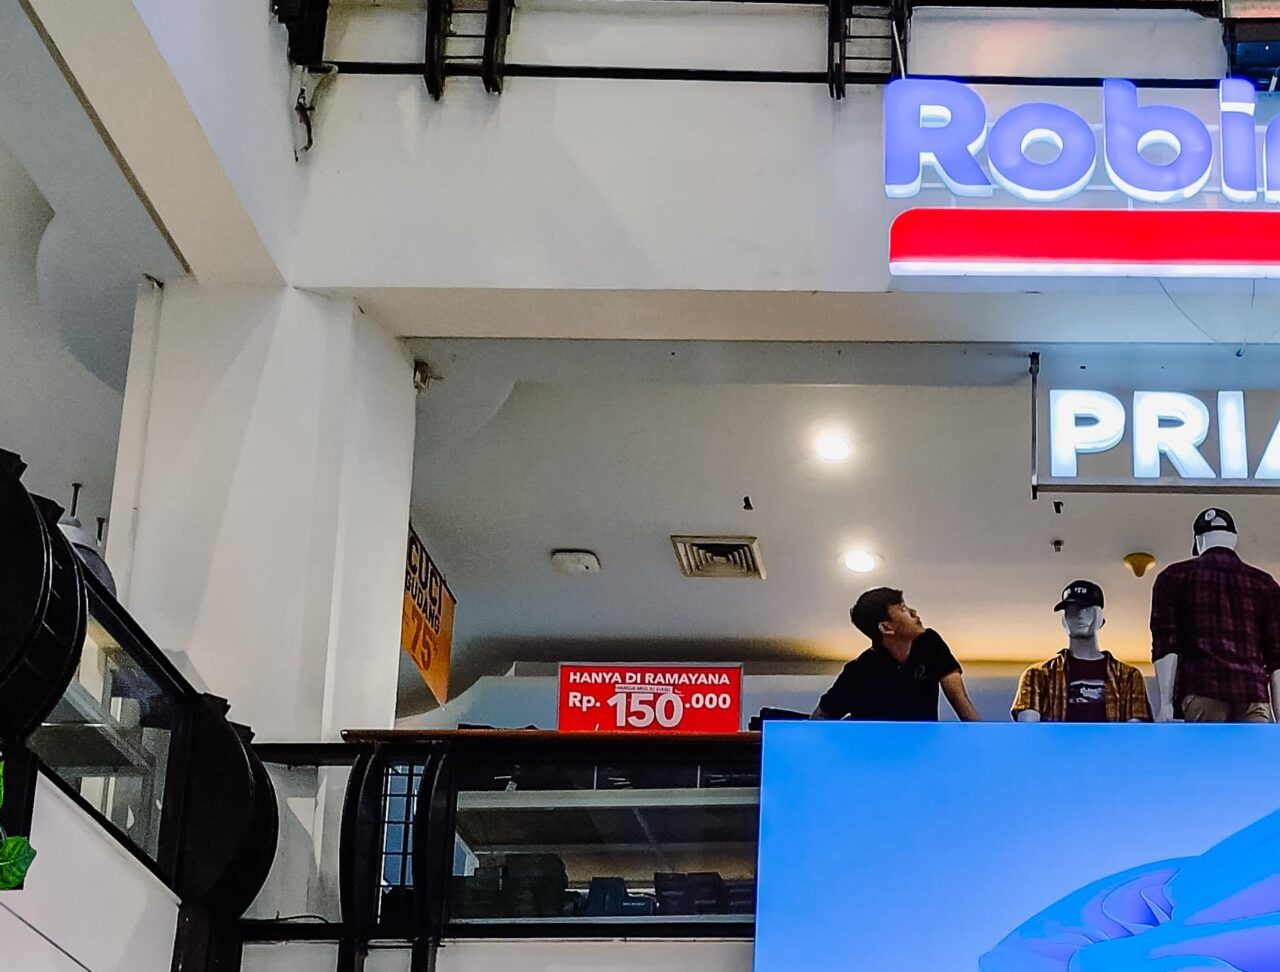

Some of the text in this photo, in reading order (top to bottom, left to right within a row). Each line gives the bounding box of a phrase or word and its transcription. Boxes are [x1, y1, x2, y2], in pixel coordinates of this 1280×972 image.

[407, 534, 442, 617] CUCI
[405, 569, 440, 636] GUDANG
[569, 671, 730, 685] HANYA DI RAMAYANA
[568, 692, 601, 712] Rp.
